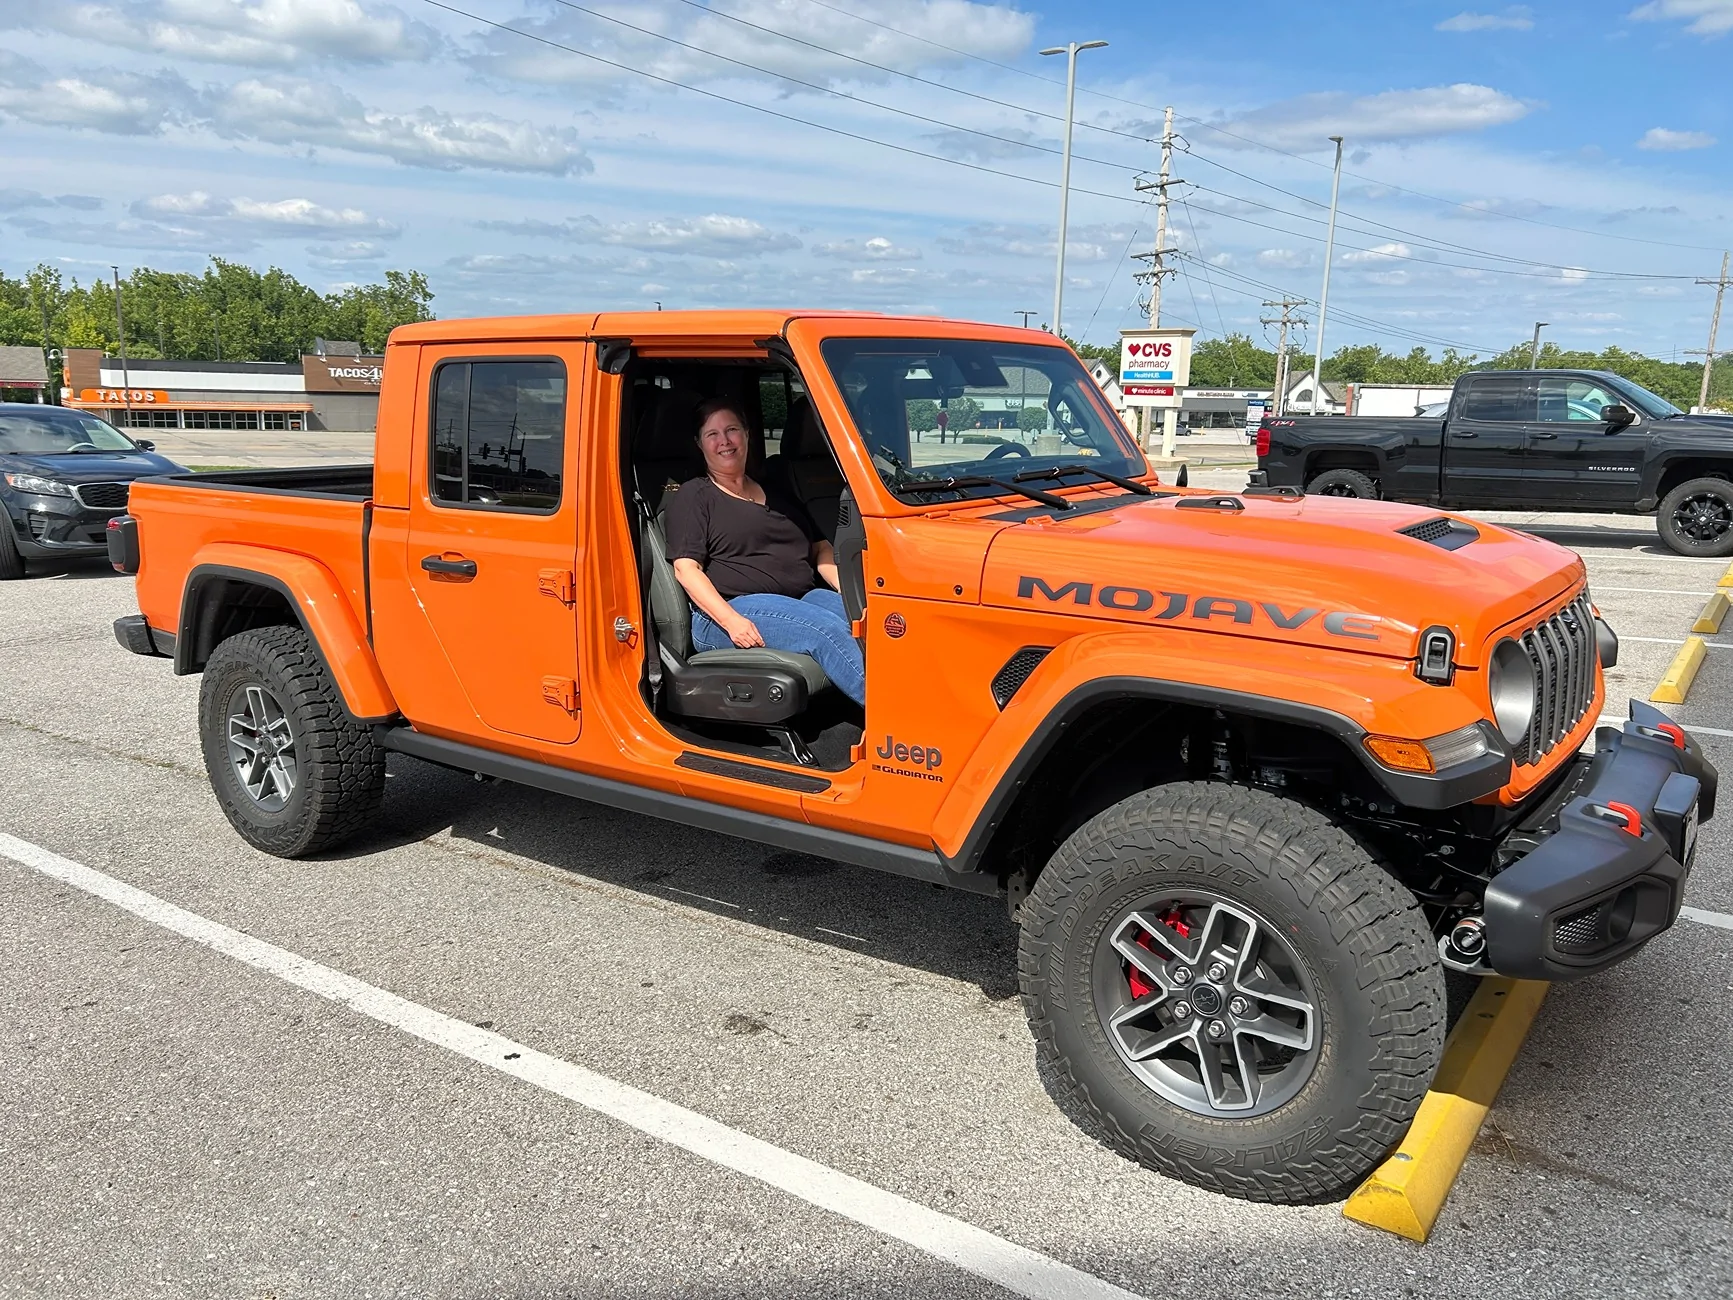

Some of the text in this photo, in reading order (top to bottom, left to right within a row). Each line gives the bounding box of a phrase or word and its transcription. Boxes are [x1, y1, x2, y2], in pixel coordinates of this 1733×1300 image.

[1142, 343, 1172, 357] CVS
[1128, 359, 1170, 370] pharmacy
[96, 389, 155, 402] TACOS
[1017, 575, 1382, 641] MOJAVE
[876, 735, 942, 771] Jeep
[881, 765, 943, 783] GLADIATOR
[1050, 853, 1172, 1011] WILDPEAK
[1178, 854, 1260, 887] A/T
[1138, 1115, 1334, 1168] FALKEN
